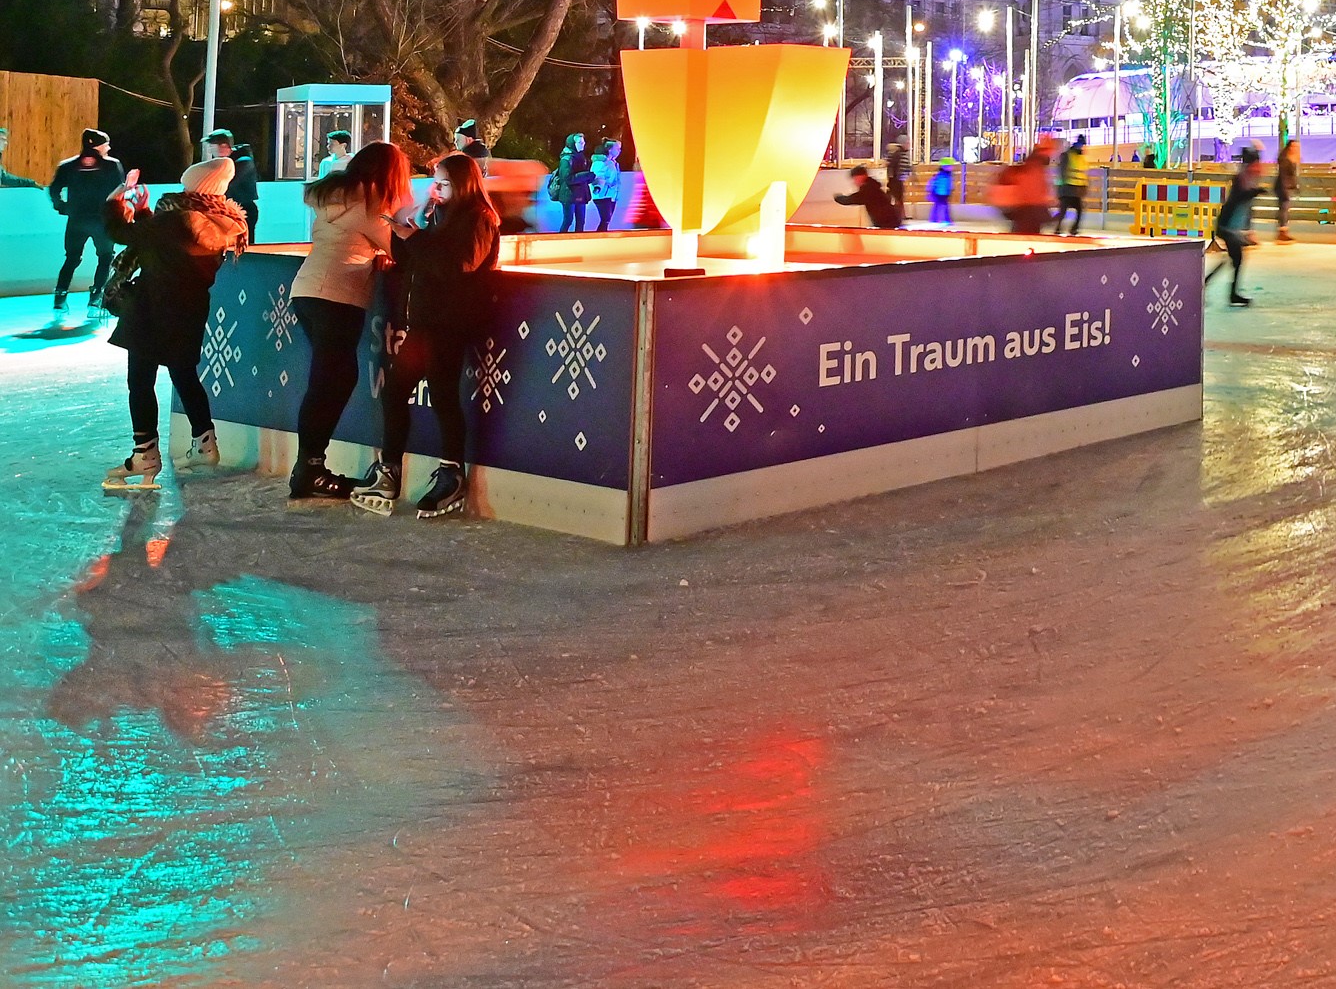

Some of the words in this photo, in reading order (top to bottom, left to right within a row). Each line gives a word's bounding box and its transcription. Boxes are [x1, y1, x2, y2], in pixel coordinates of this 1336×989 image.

[370, 315, 409, 355] Sta
[818, 340, 877, 387] Ein
[887, 333, 995, 376] Traum
[1003, 325, 1056, 359] aus
[1064, 308, 1111, 351] Eis!
